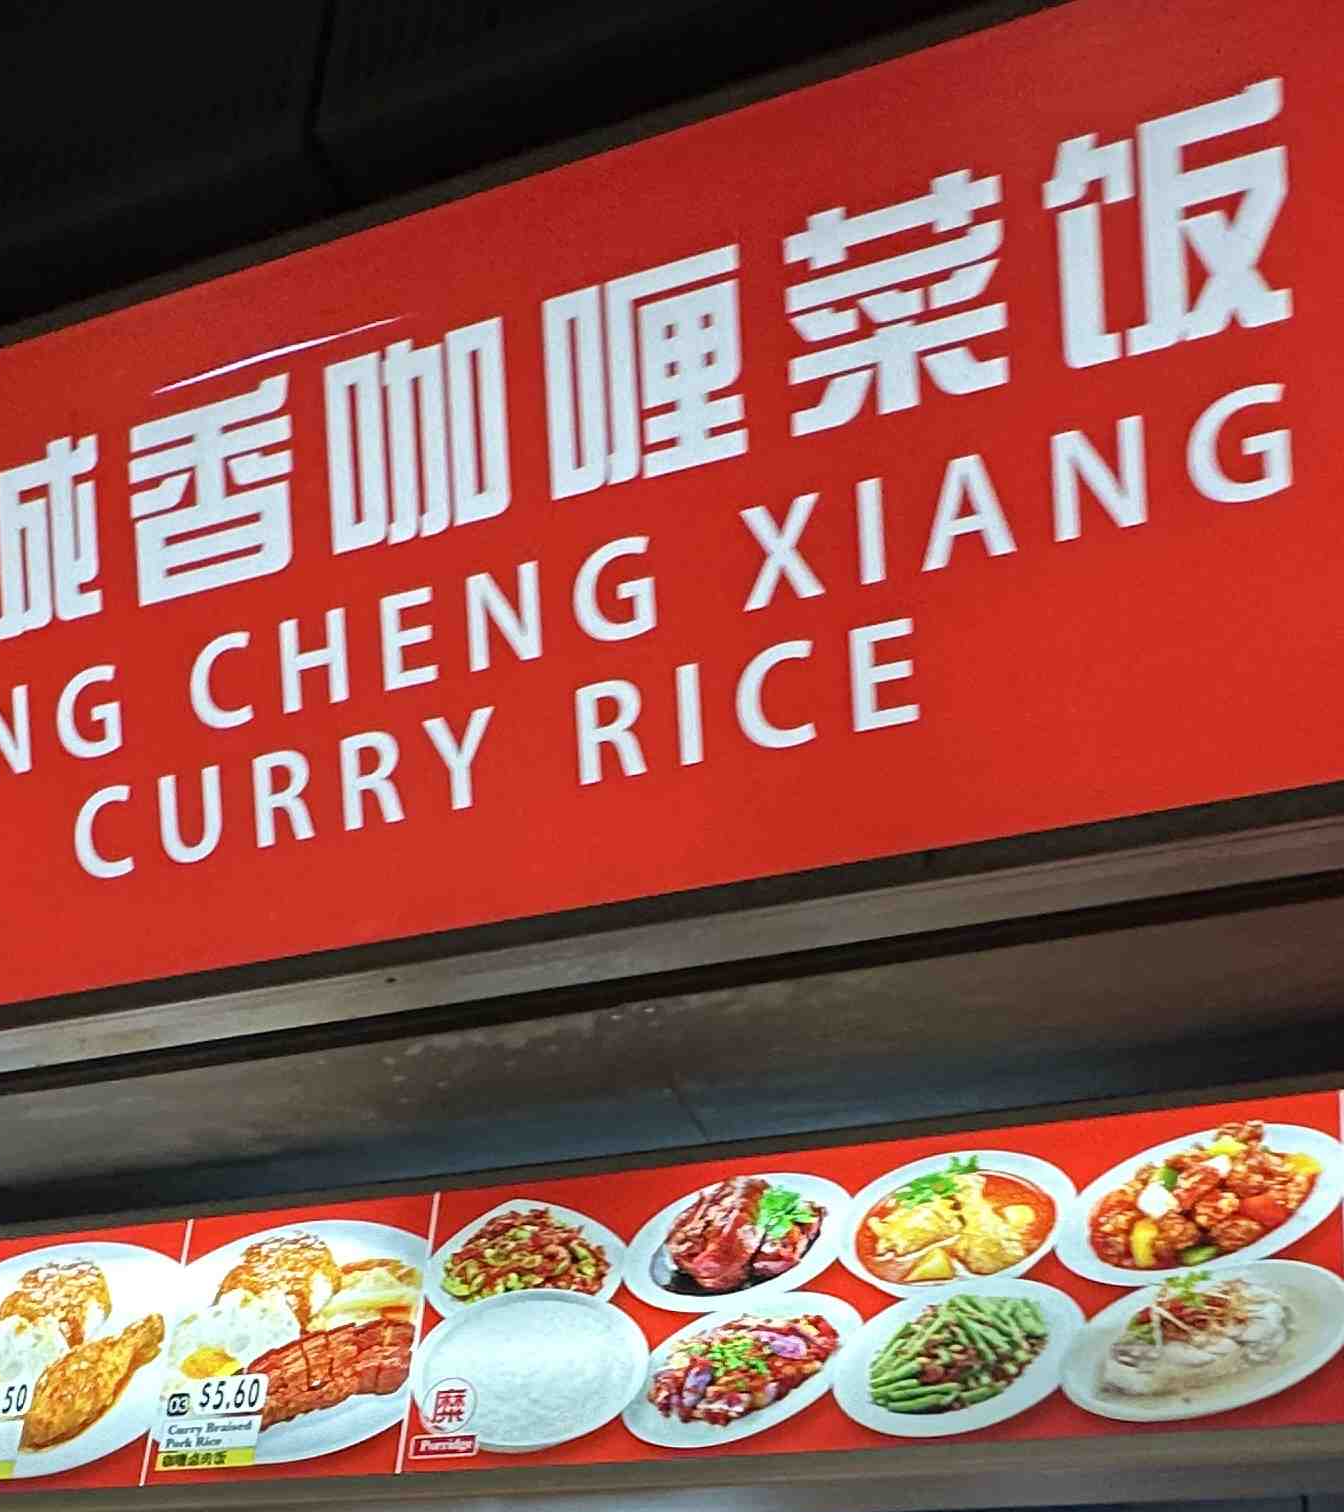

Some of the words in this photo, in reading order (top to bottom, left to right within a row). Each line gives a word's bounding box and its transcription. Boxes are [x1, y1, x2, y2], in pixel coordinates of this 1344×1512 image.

[190, 537, 656, 729] CHENG
[740, 384, 1292, 612] XIANG
[74, 707, 494, 879] CURRY
[575, 619, 919, 785] RICE
[167, 1424, 203, 1437] Curry
[198, 1378, 261, 1411] $5.60
